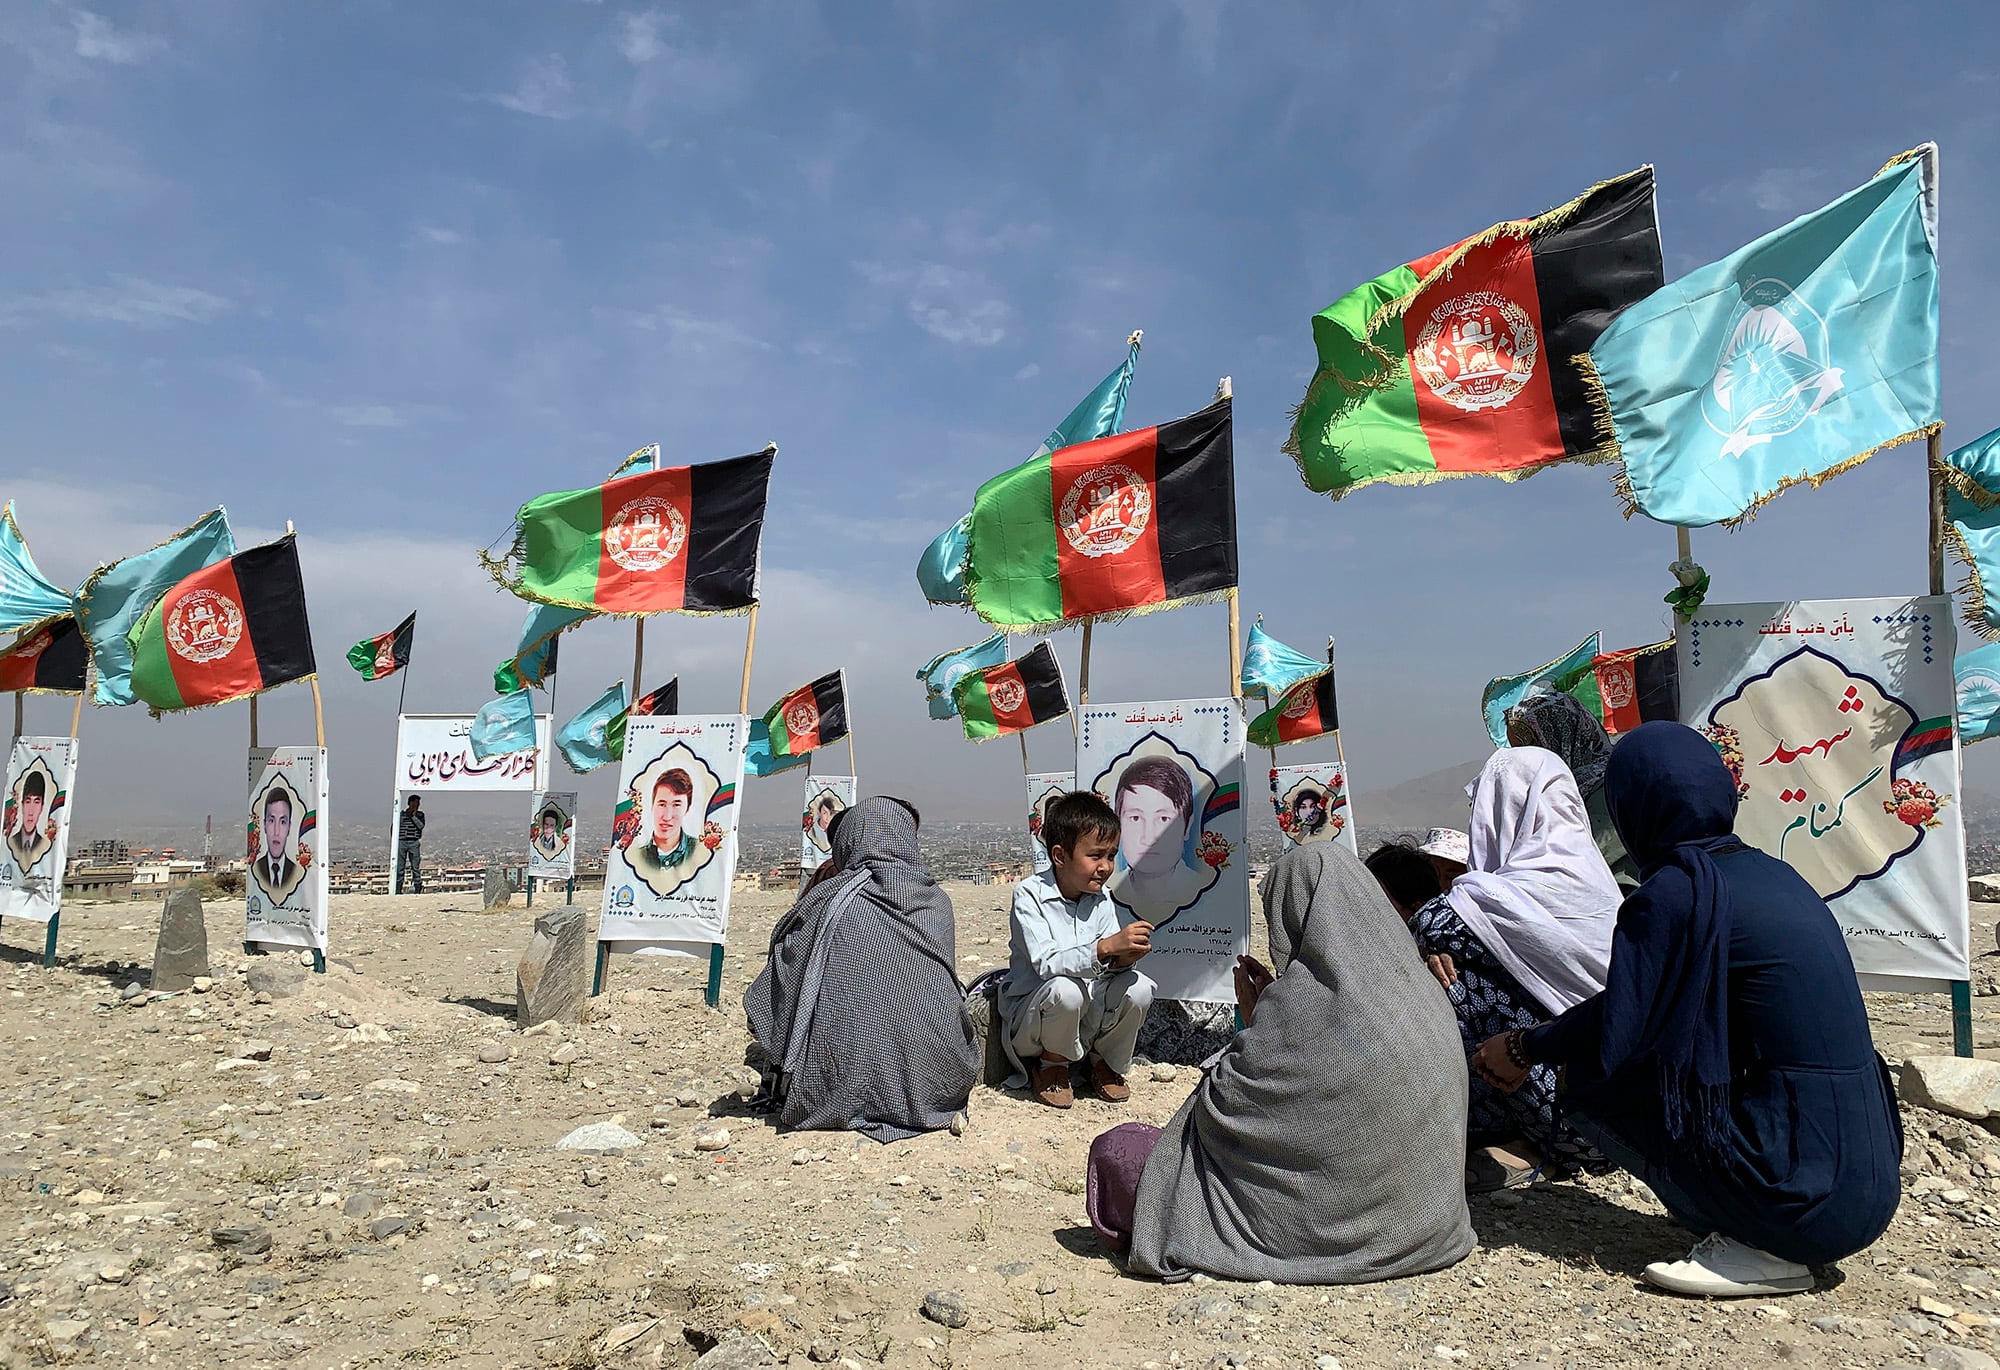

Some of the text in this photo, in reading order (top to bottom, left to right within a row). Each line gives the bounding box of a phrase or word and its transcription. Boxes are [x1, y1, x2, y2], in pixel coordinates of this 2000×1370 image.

[1758, 685, 1864, 767] شهید
[1168, 924, 1191, 934] صفدری
[1217, 926, 1232, 935] شهید
[1845, 926, 1862, 937] مرکز
